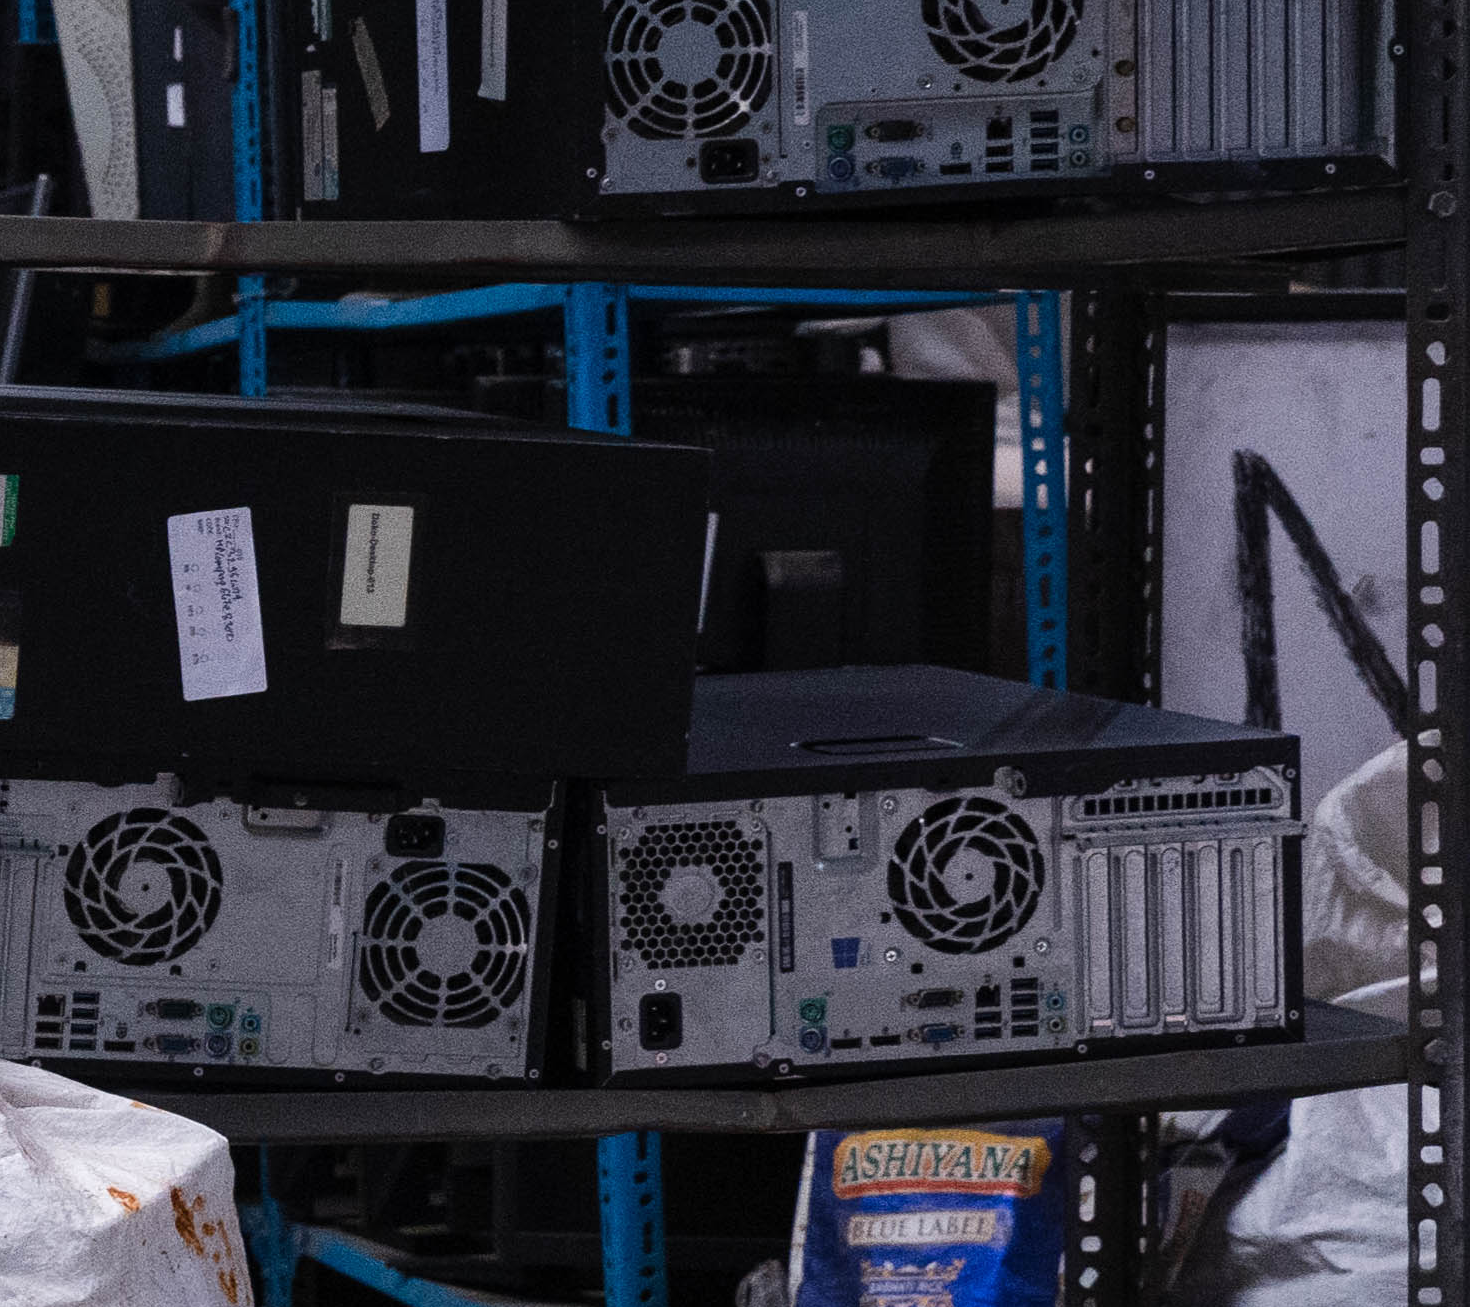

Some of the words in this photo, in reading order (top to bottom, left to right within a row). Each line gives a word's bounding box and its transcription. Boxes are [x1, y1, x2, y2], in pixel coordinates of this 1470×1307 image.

[840, 1143, 1034, 1185] ASHIYANA
[851, 1218, 907, 1241] BLUE
[916, 1214, 992, 1239] LABEL
